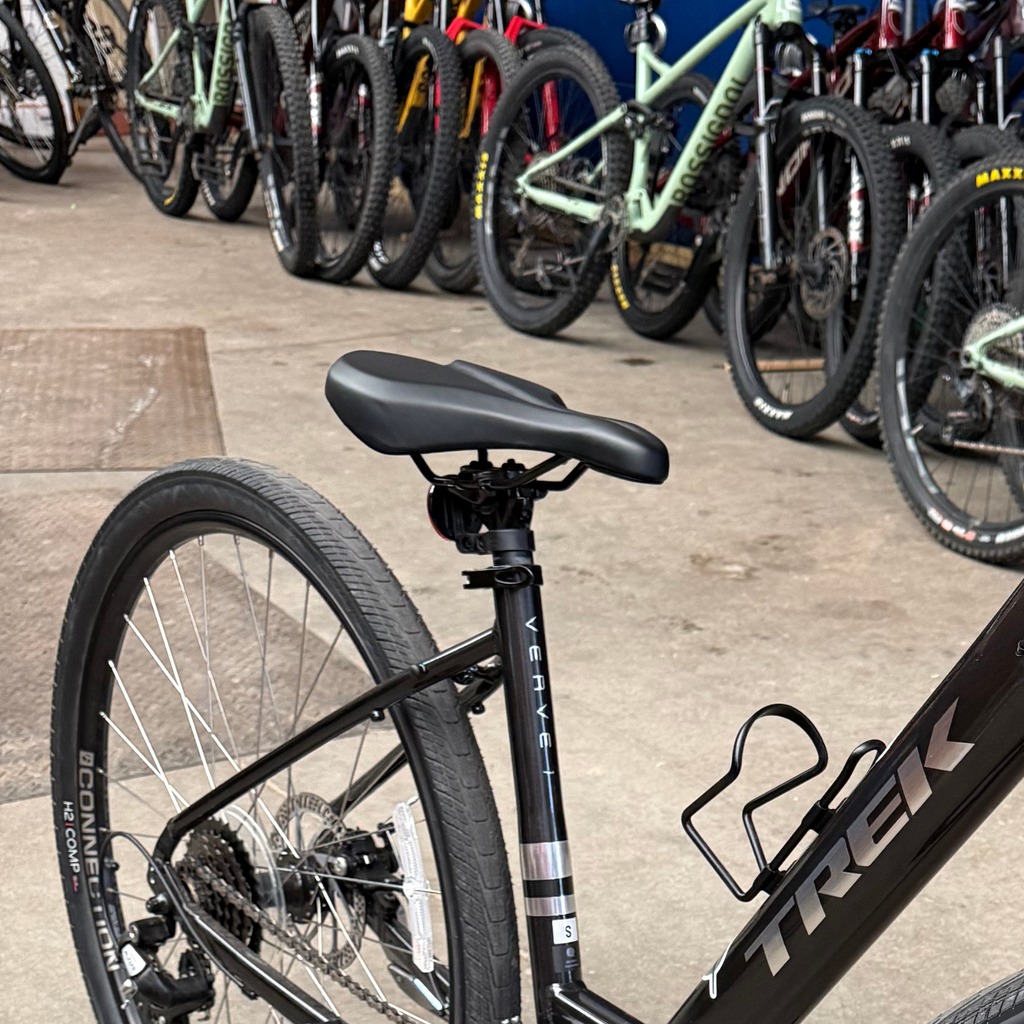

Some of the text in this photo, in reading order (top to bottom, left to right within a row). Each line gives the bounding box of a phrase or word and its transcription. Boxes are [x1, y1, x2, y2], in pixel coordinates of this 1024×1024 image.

[674, 77, 748, 204] ROSSIGNOL
[525, 616, 552, 748] VERVE
[744, 698, 975, 977] TREK
[565, 925, 572, 938] S
